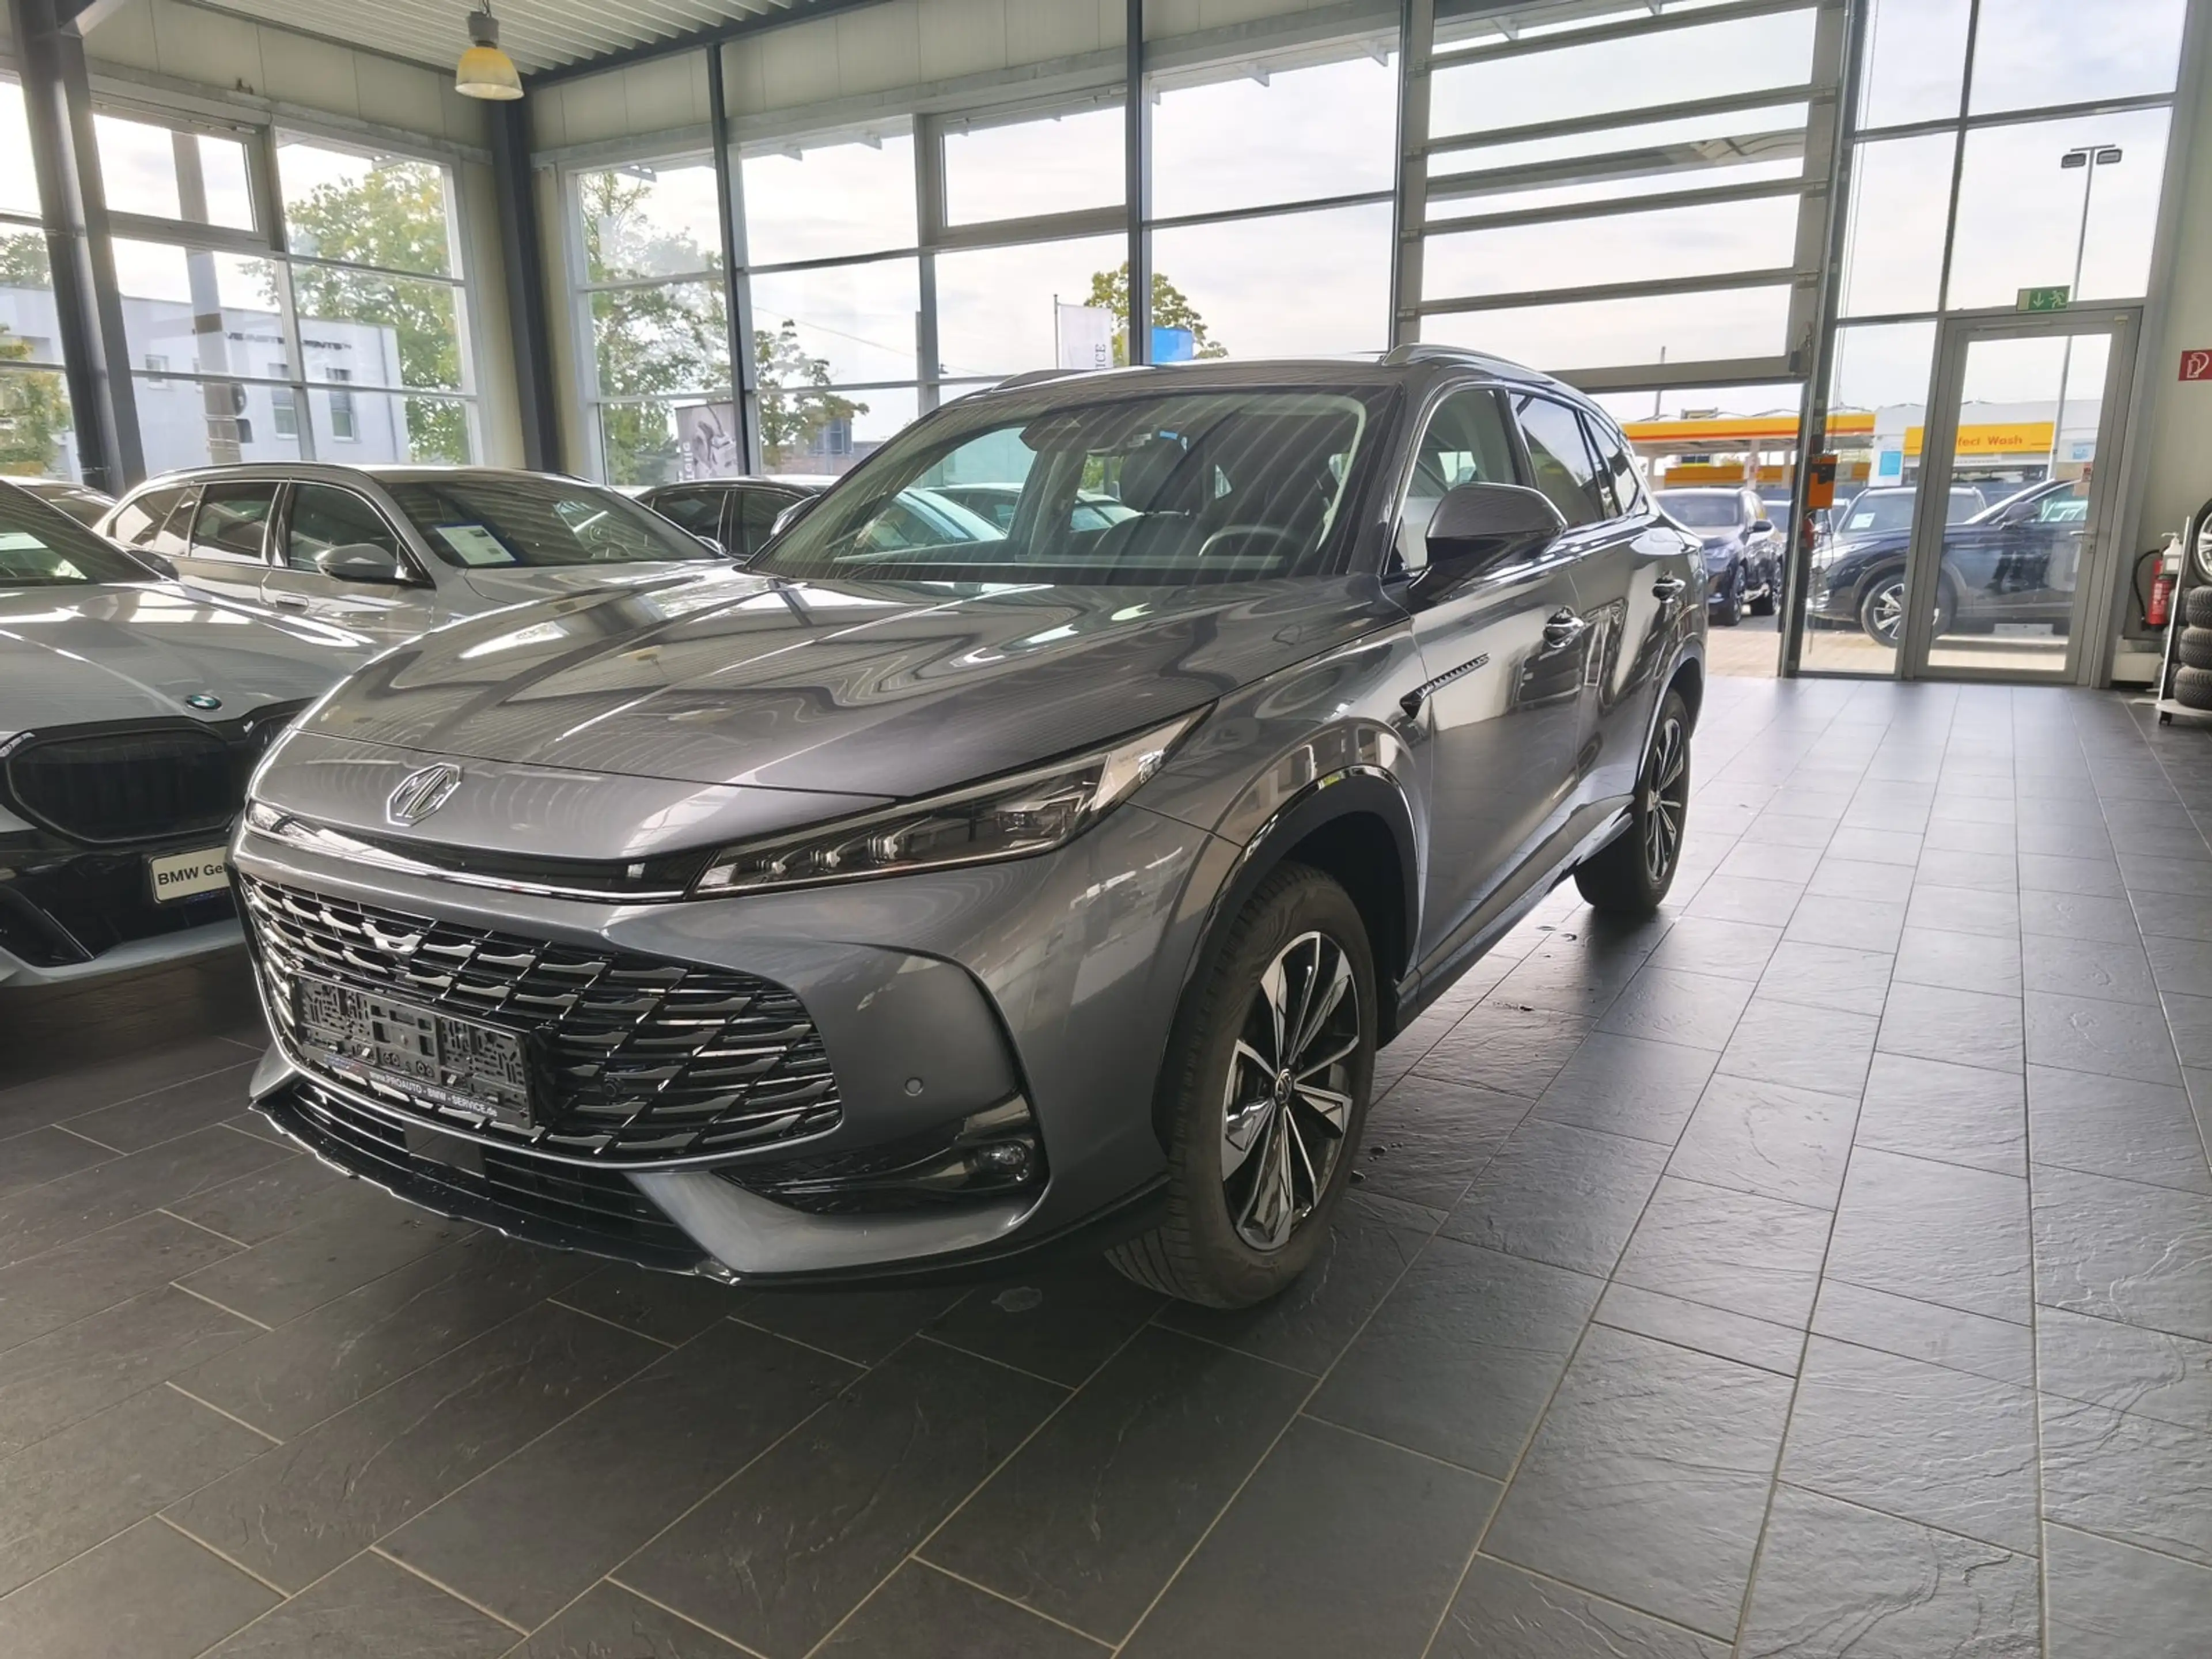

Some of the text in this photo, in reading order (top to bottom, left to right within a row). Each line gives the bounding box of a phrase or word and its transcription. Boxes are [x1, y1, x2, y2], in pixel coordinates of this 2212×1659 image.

[1956, 434, 2022, 446] fect Wash
[158, 866, 198, 885] BMW
